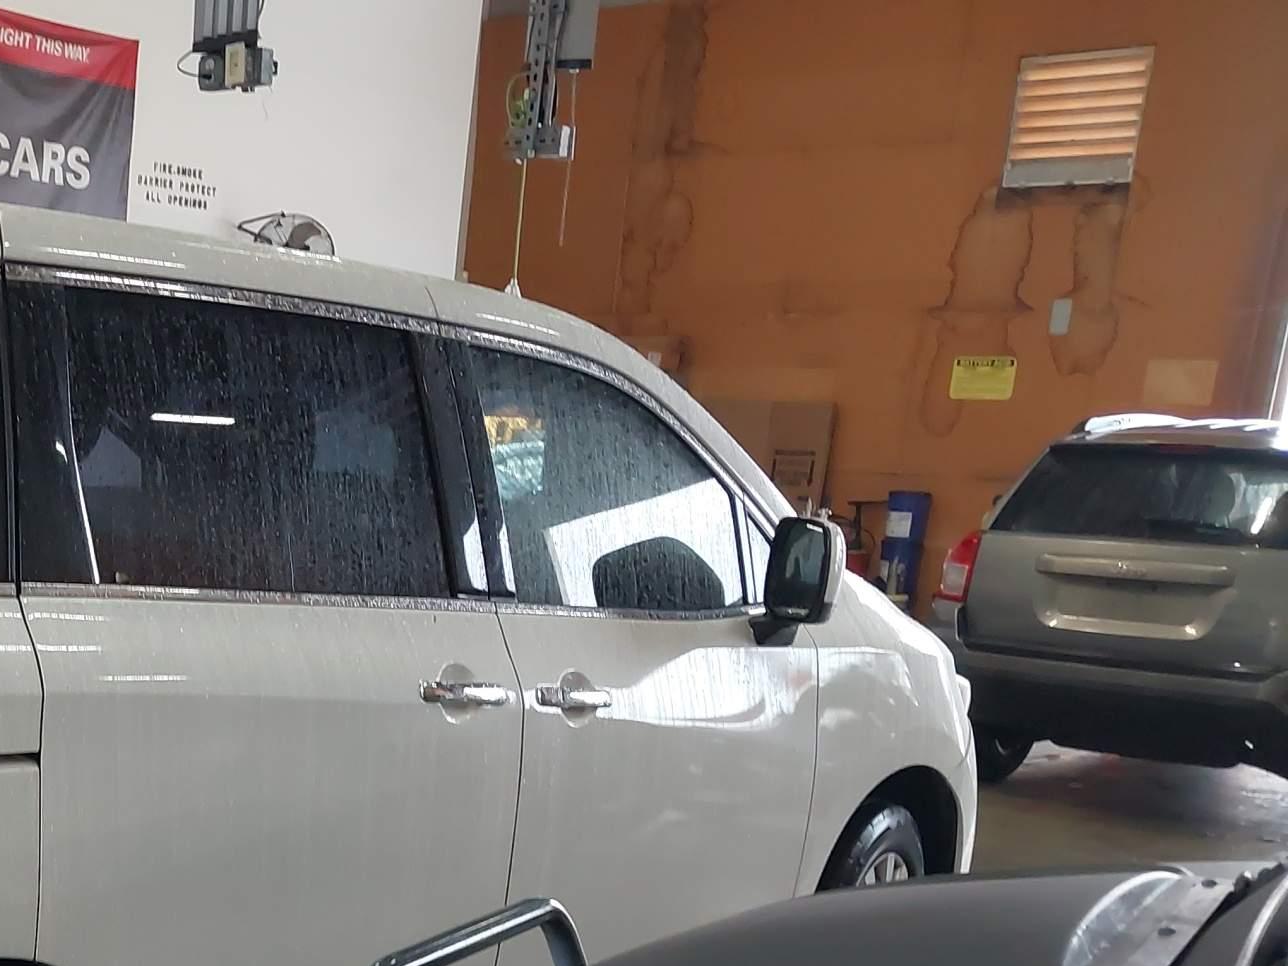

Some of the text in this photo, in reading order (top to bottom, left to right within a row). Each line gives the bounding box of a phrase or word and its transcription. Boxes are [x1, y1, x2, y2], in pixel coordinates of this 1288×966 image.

[35, 34, 62, 58] THIS
[137, 174, 216, 197] BARRIER PROTECT
[145, 190, 208, 210] ALL OPENINGS
